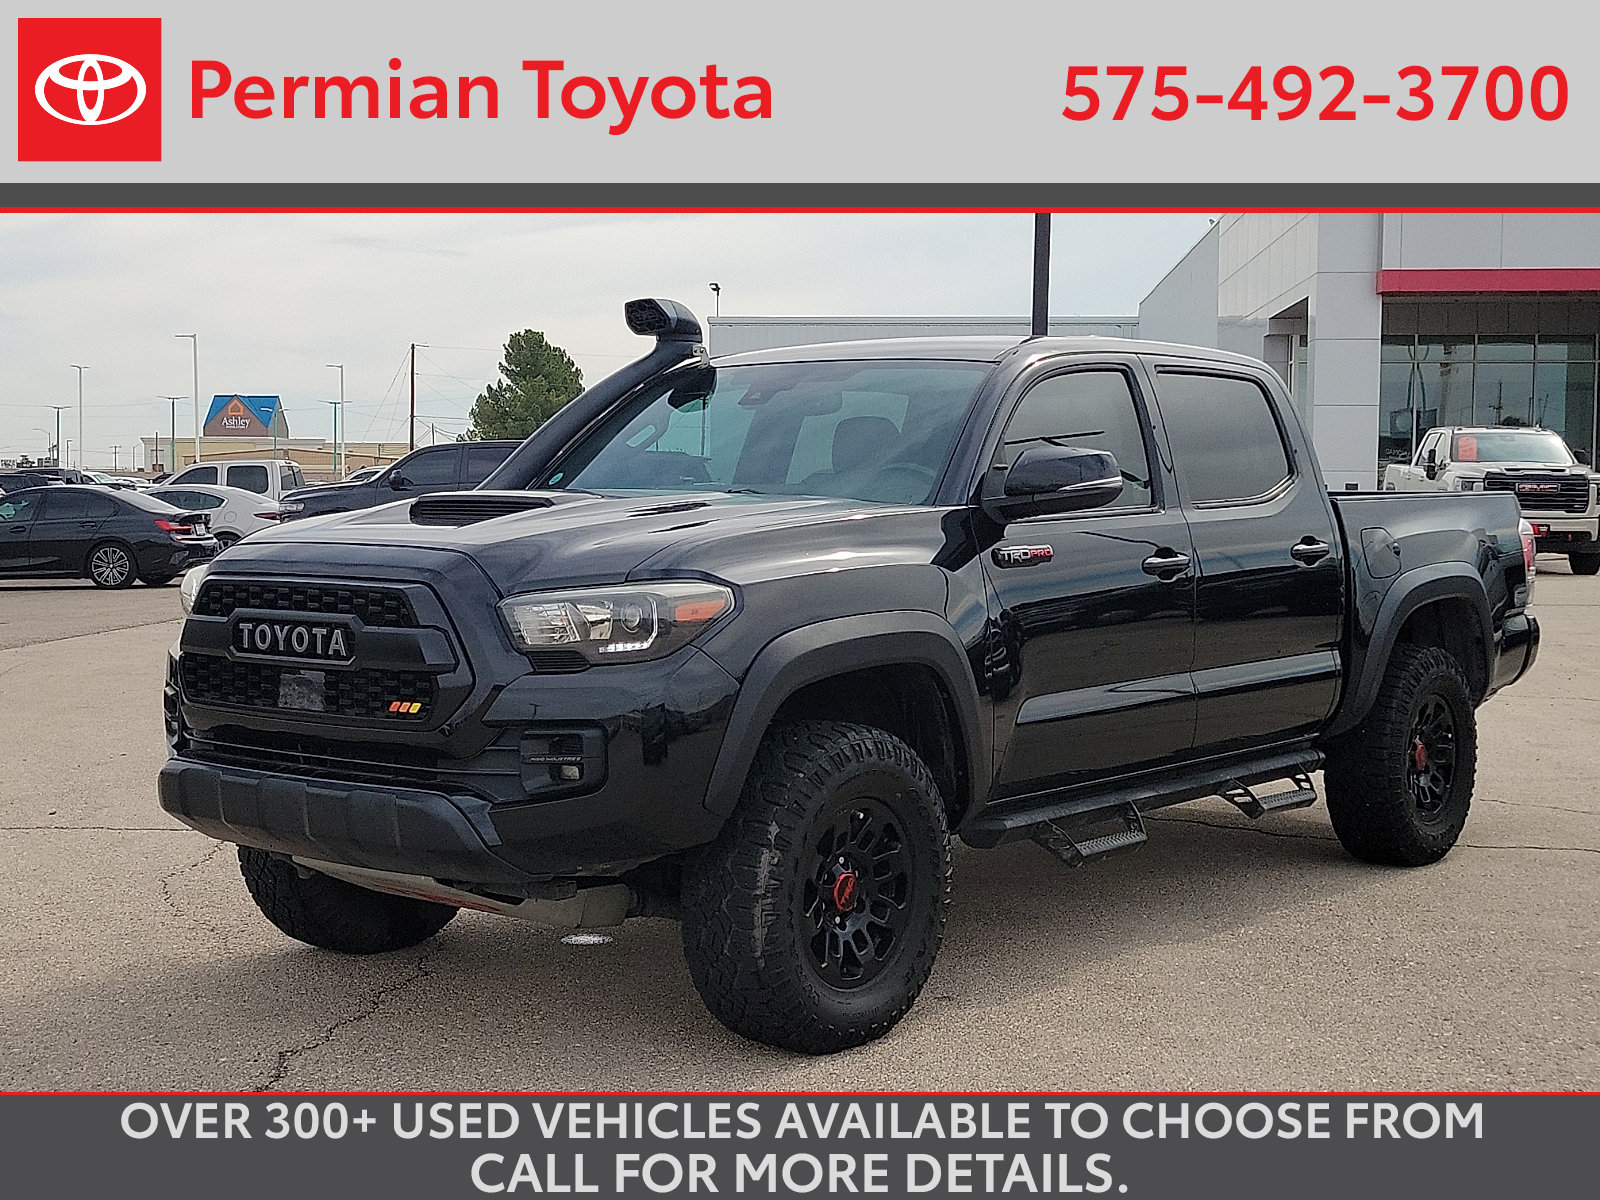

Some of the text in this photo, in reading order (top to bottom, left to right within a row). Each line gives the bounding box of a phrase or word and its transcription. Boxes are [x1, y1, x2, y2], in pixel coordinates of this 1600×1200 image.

[221, 416, 251, 429] Ashley
[999, 548, 1052, 563] TRD PRO
[239, 622, 347, 657] TOYOTA
